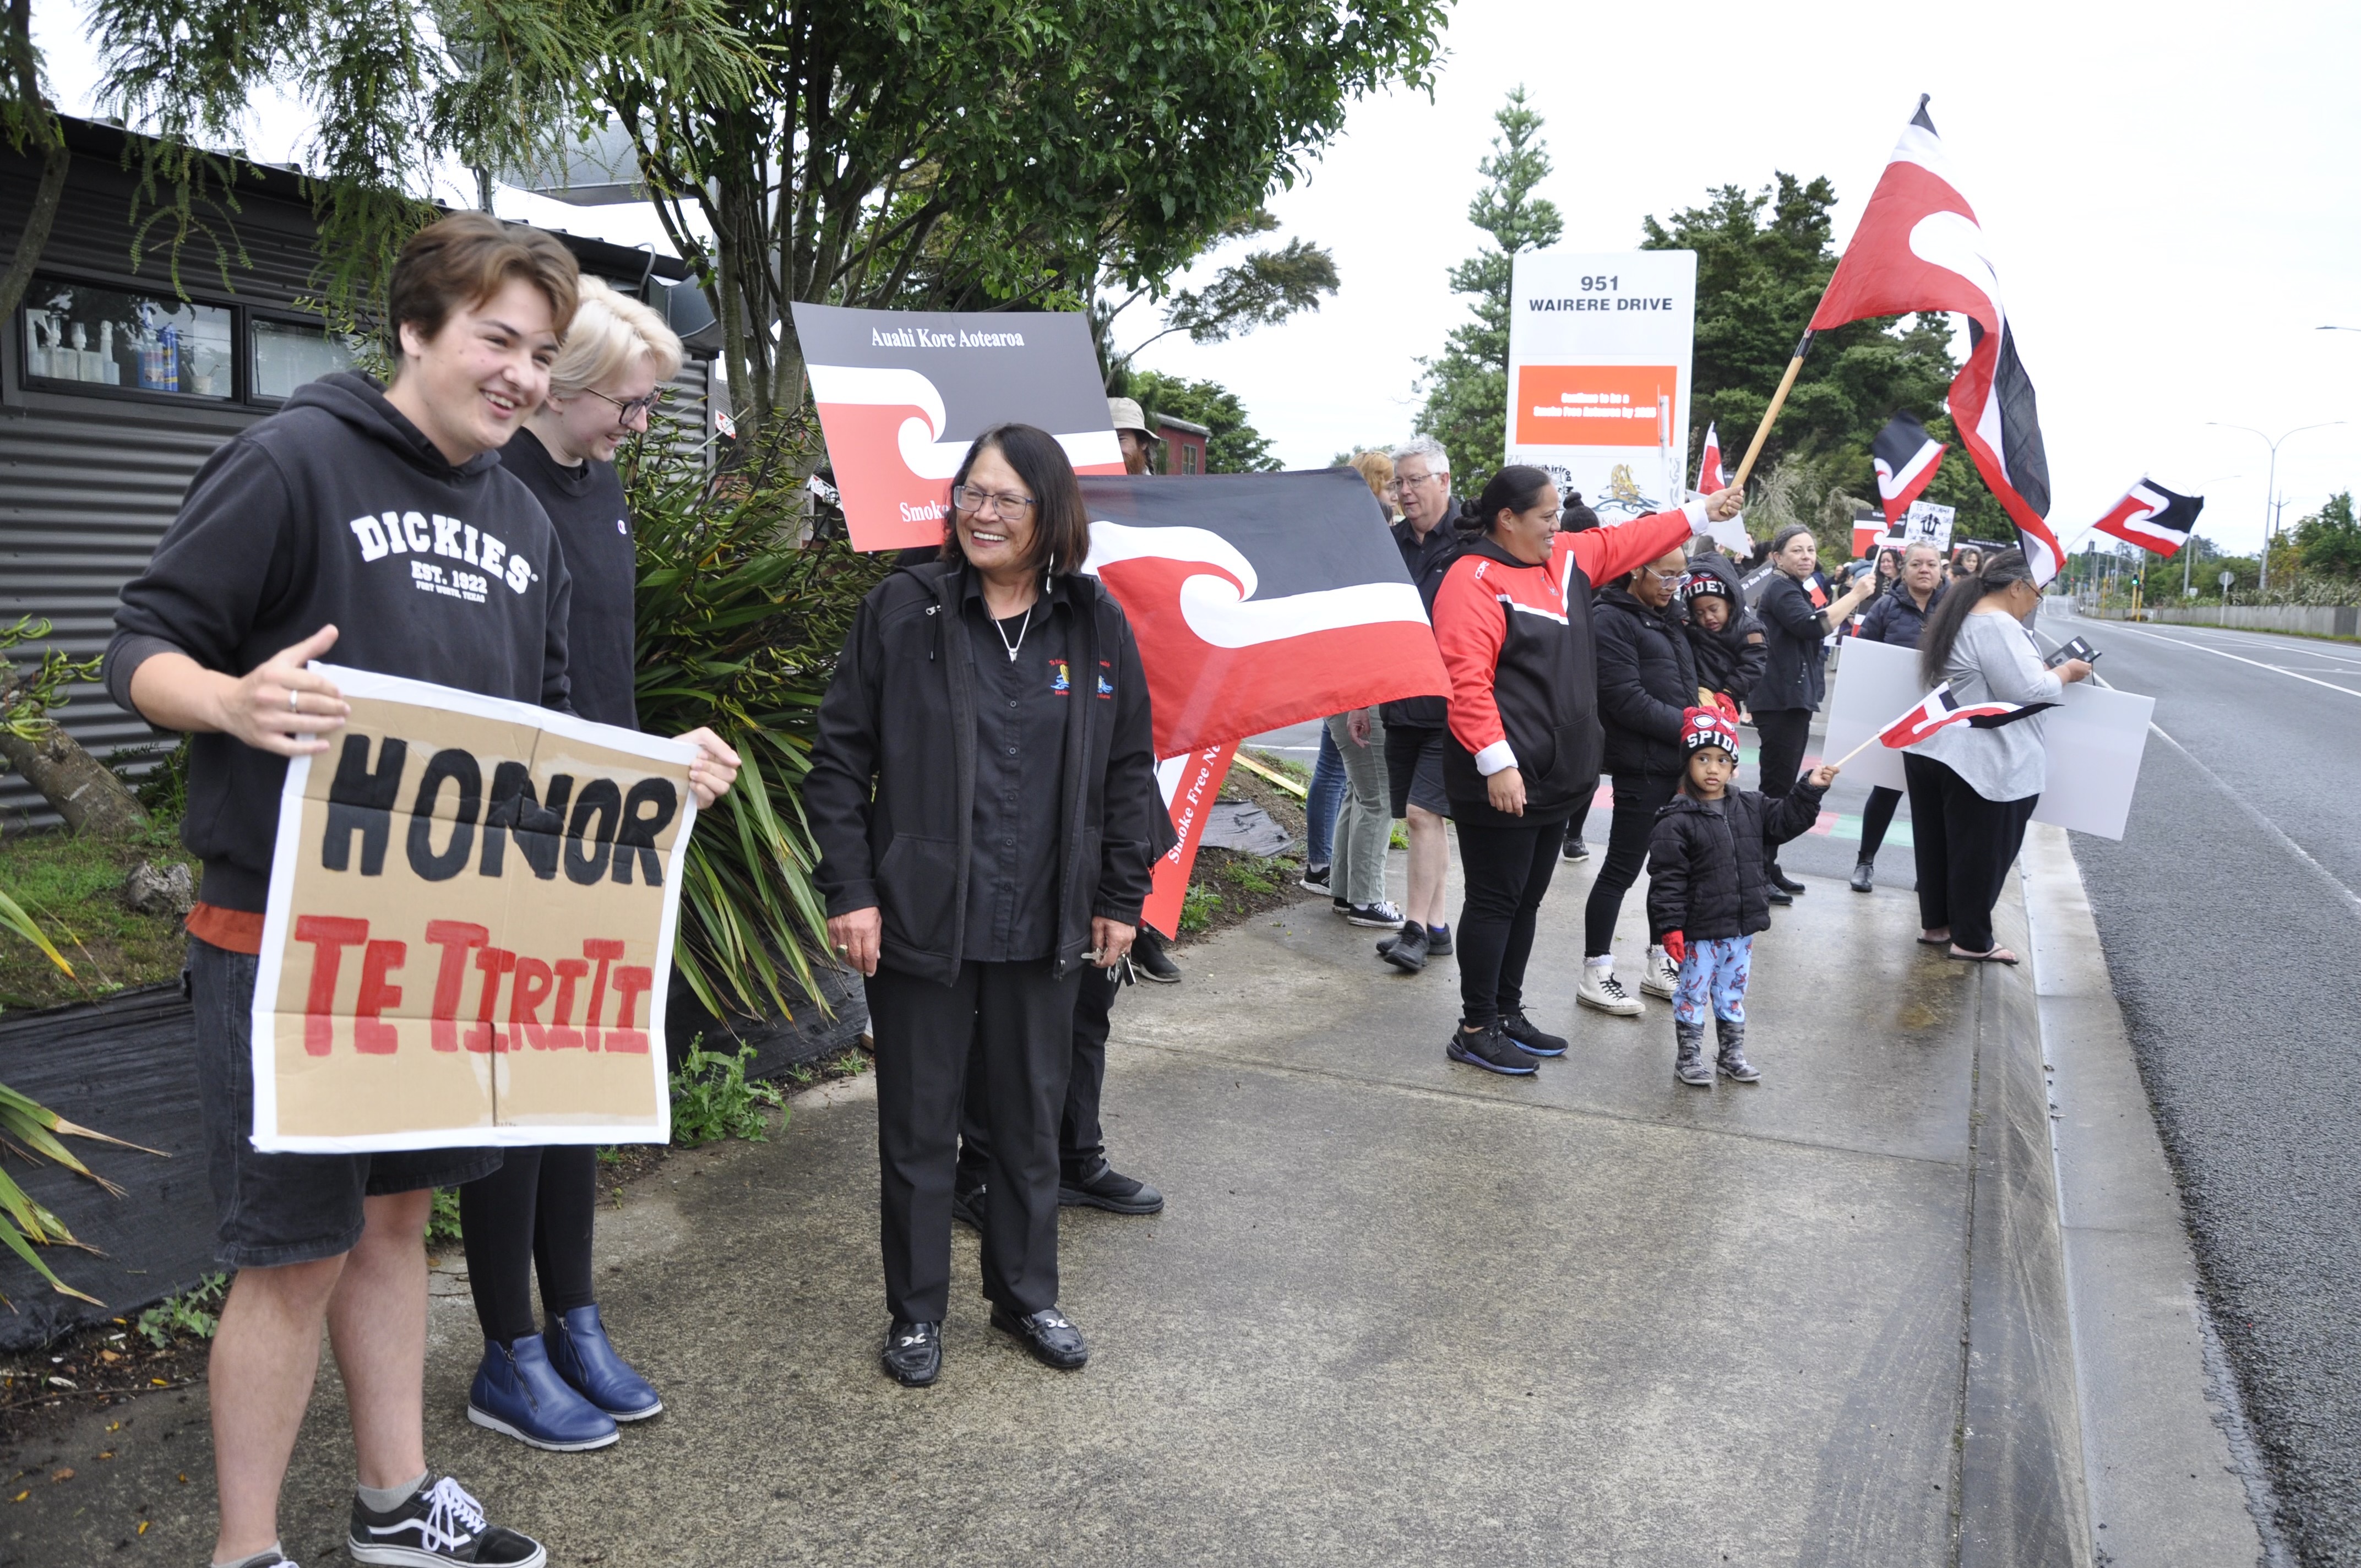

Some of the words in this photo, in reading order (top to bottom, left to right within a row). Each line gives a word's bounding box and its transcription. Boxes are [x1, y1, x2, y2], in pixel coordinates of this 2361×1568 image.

[1581, 276, 1618, 291] 951
[1529, 299, 1610, 311] WAIRERE
[1617, 298, 1672, 311] DRIVE
[872, 327, 916, 347] Auahi
[916, 329, 956, 347] Kore
[959, 329, 1025, 347] Aotearoa
[350, 511, 531, 594] DICKIES
[411, 560, 448, 585] EST.
[452, 570, 488, 594] 1922
[1687, 730, 1739, 760] SPIDE
[1187, 767, 1209, 807] Free
[1203, 745, 1221, 767] Ne
[322, 734, 677, 887] HONOR
[295, 915, 406, 1057] TE
[425, 919, 652, 1054] TIRITI
